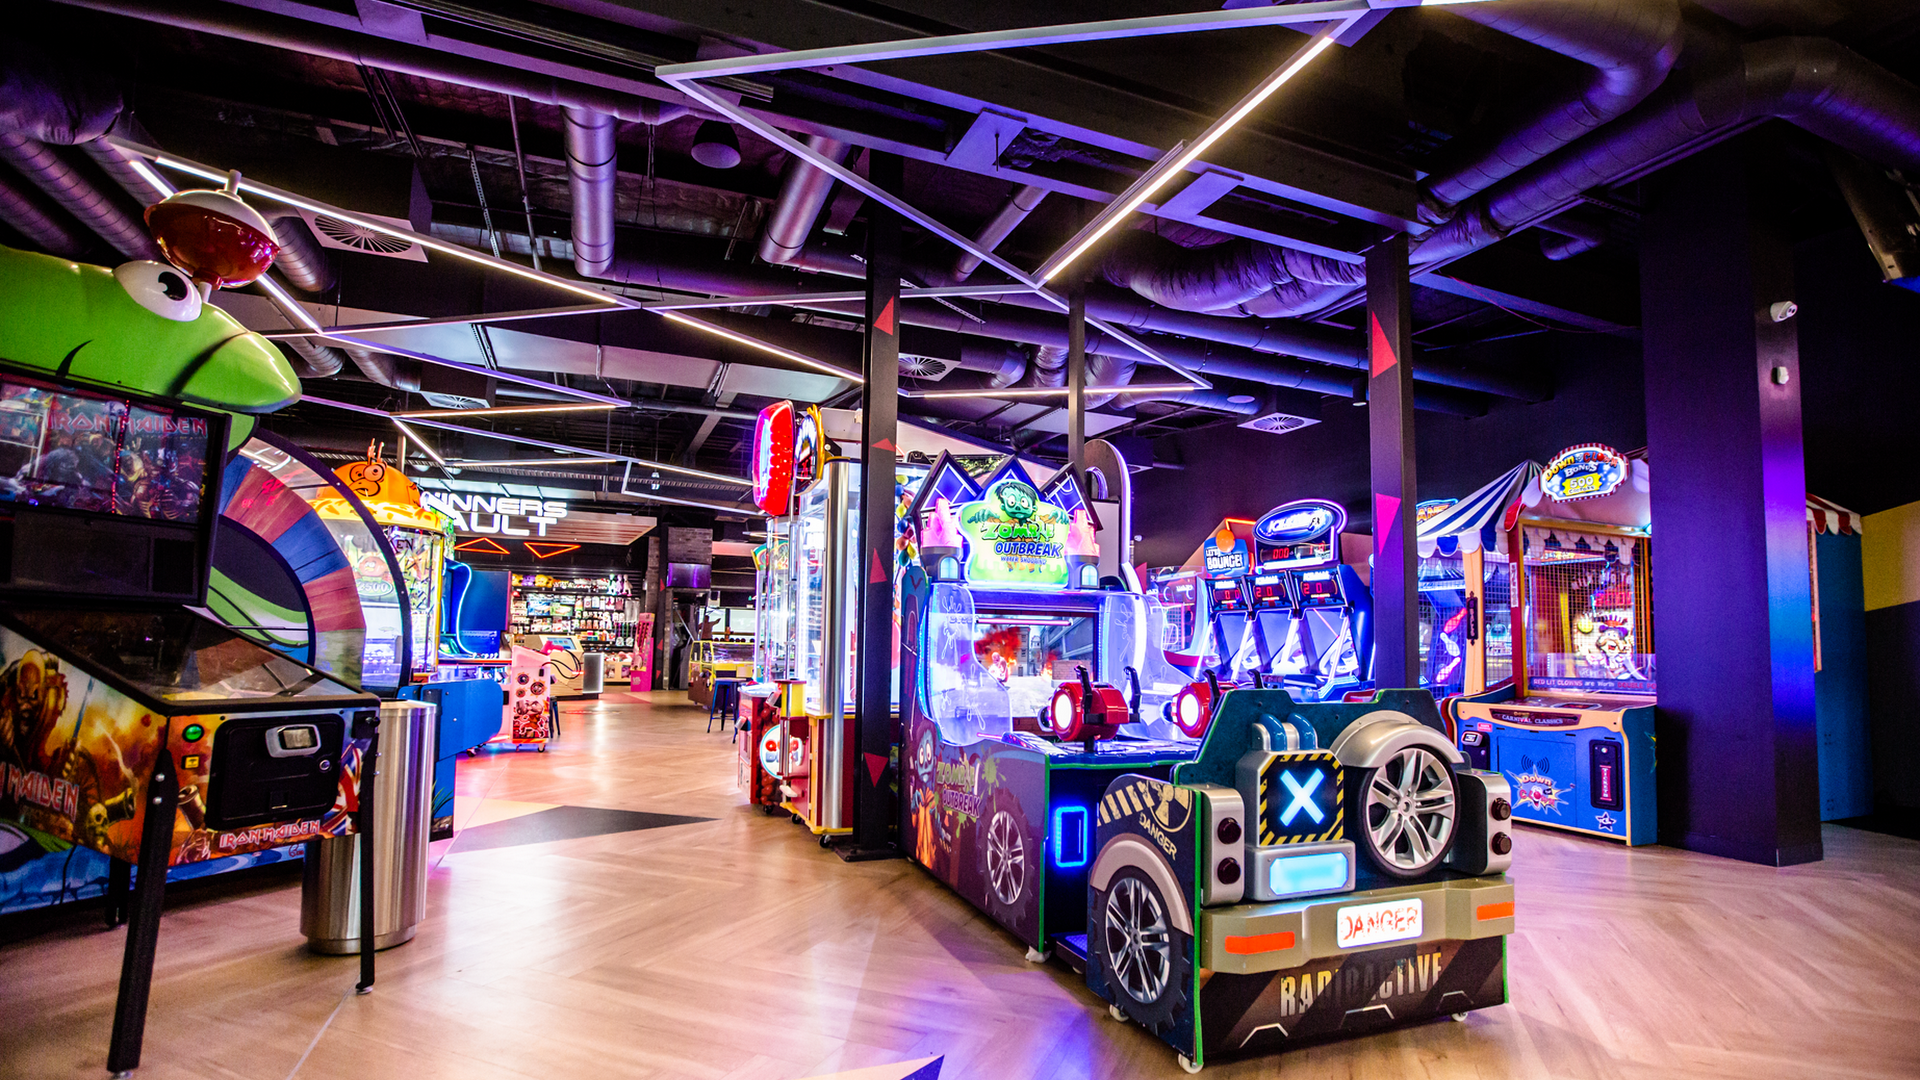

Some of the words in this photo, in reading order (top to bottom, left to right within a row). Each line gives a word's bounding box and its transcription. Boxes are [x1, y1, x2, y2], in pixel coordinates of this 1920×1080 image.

[117, 414, 208, 439] MAIDEN
[1570, 476, 1594, 488] 500
[453, 511, 558, 537] AULT
[995, 541, 1063, 559] OUTBREAK
[1273, 547, 1290, 560] 000
[1533, 678, 1545, 686] RED
[1557, 679, 1583, 687] CLOWNS
[1617, 681, 1644, 690] DOUBLE
[1501, 714, 1532, 723] CARNIVAL
[1534, 717, 1563, 725] CLASSICS
[7, 762, 80, 824] MAIDEN
[1521, 775, 1552, 786] Down
[942, 788, 981, 818] OUTBREAK
[219, 828, 261, 849] IRON
[262, 819, 321, 843] MAIDEN
[1139, 812, 1177, 861] DANGER
[1341, 906, 1419, 941] DANGER
[1280, 952, 1442, 1018] RADIOACTIVE
